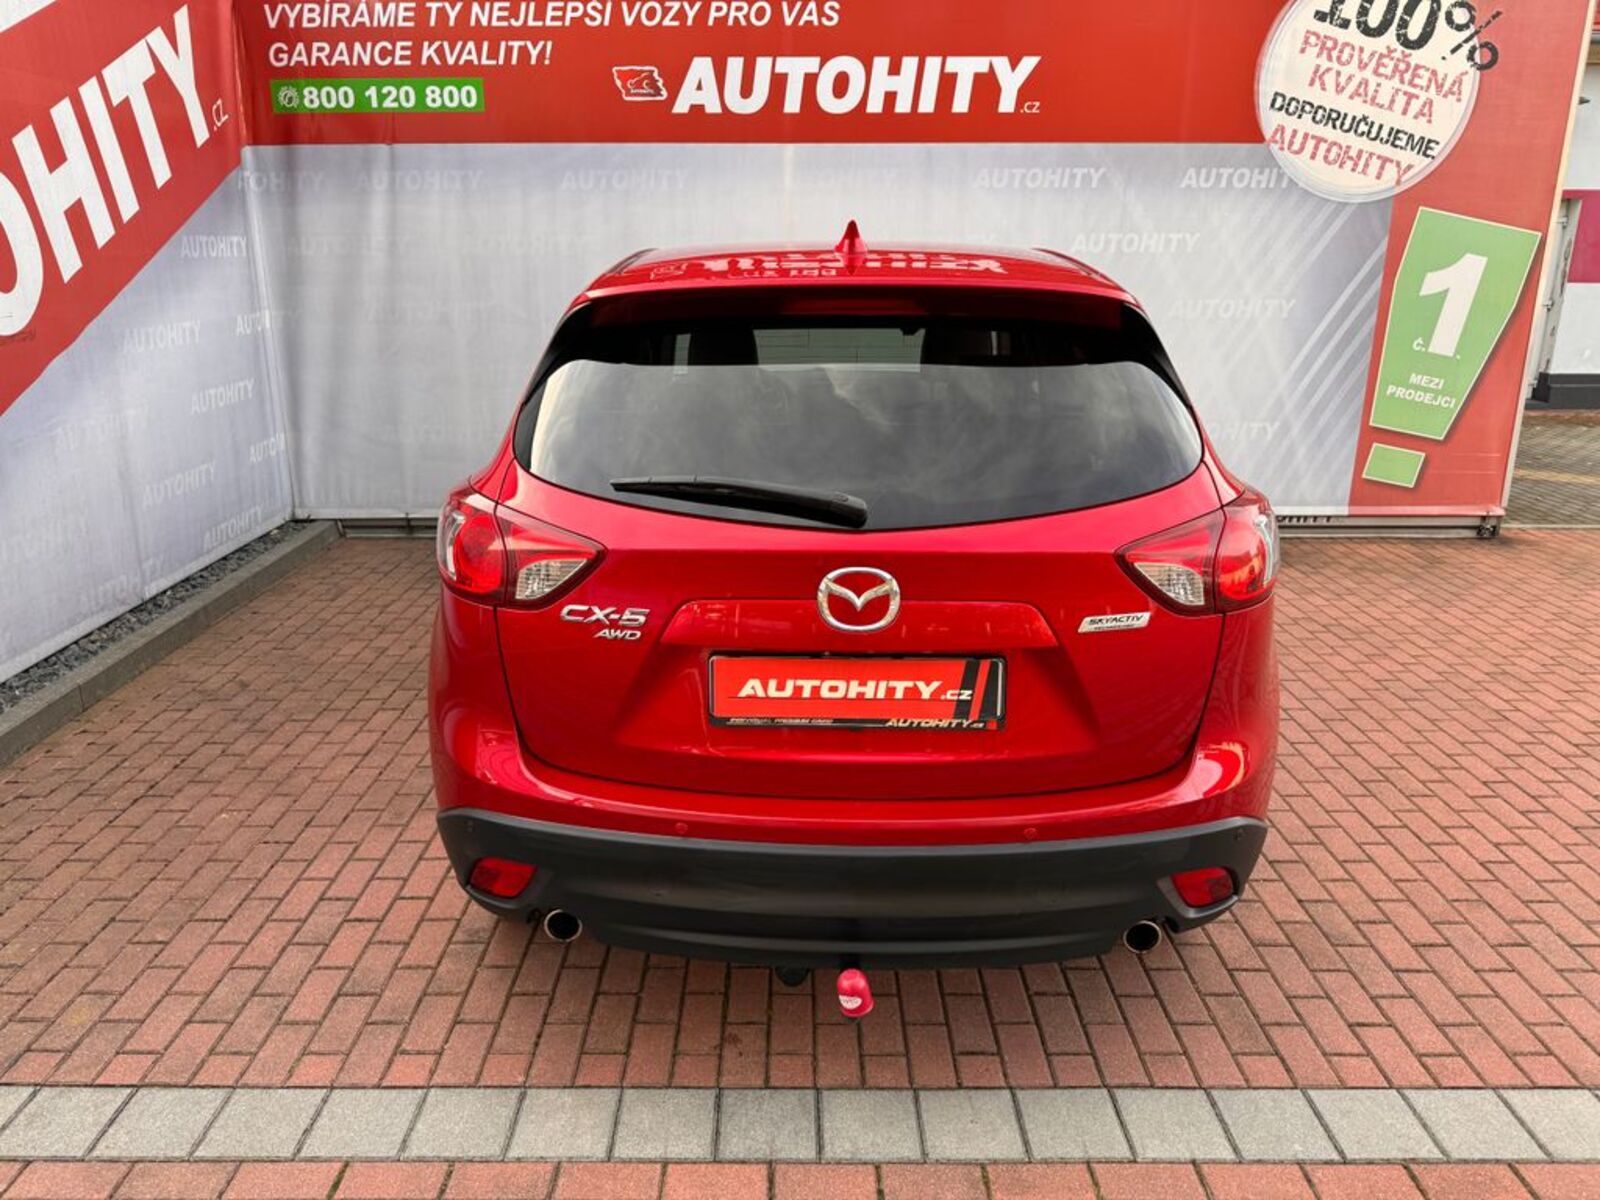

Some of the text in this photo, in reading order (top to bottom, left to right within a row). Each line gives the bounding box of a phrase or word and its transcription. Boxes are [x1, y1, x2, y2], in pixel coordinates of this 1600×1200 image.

[263, 0, 416, 28] VYBÍRÁME
[425, 2, 463, 27] TY
[620, 1, 702, 27] VOZY
[707, 1, 772, 26] PRO
[268, 40, 553, 67] GARANCE KVALITY!
[1299, 29, 1469, 102] PROVĚŘENÁ
[303, 85, 477, 109] 800 120 800
[1307, 63, 1435, 124] KVALITA
[1267, 123, 1415, 187] AUTOHITY
[974, 167, 1106, 190] AUTOHITY
[180, 235, 248, 259] AUTOHITY
[1070, 232, 1201, 254] AUTOHITY
[1166, 299, 1297, 320] AUTOHITY
[123, 321, 201, 353] AUTOHITY
[1409, 373, 1445, 391] MEZI
[190, 378, 255, 415] AUTOHITY
[1386, 384, 1457, 409] PRODEJCI
[142, 460, 216, 511] AUTOHITY
[203, 504, 264, 552] AUTOHITY
[560, 604, 651, 627] CX-5
[1088, 614, 1145, 625] SKYACTIV
[592, 627, 642, 641] AWD
[737, 679, 973, 700] AUTOHITY.cz
